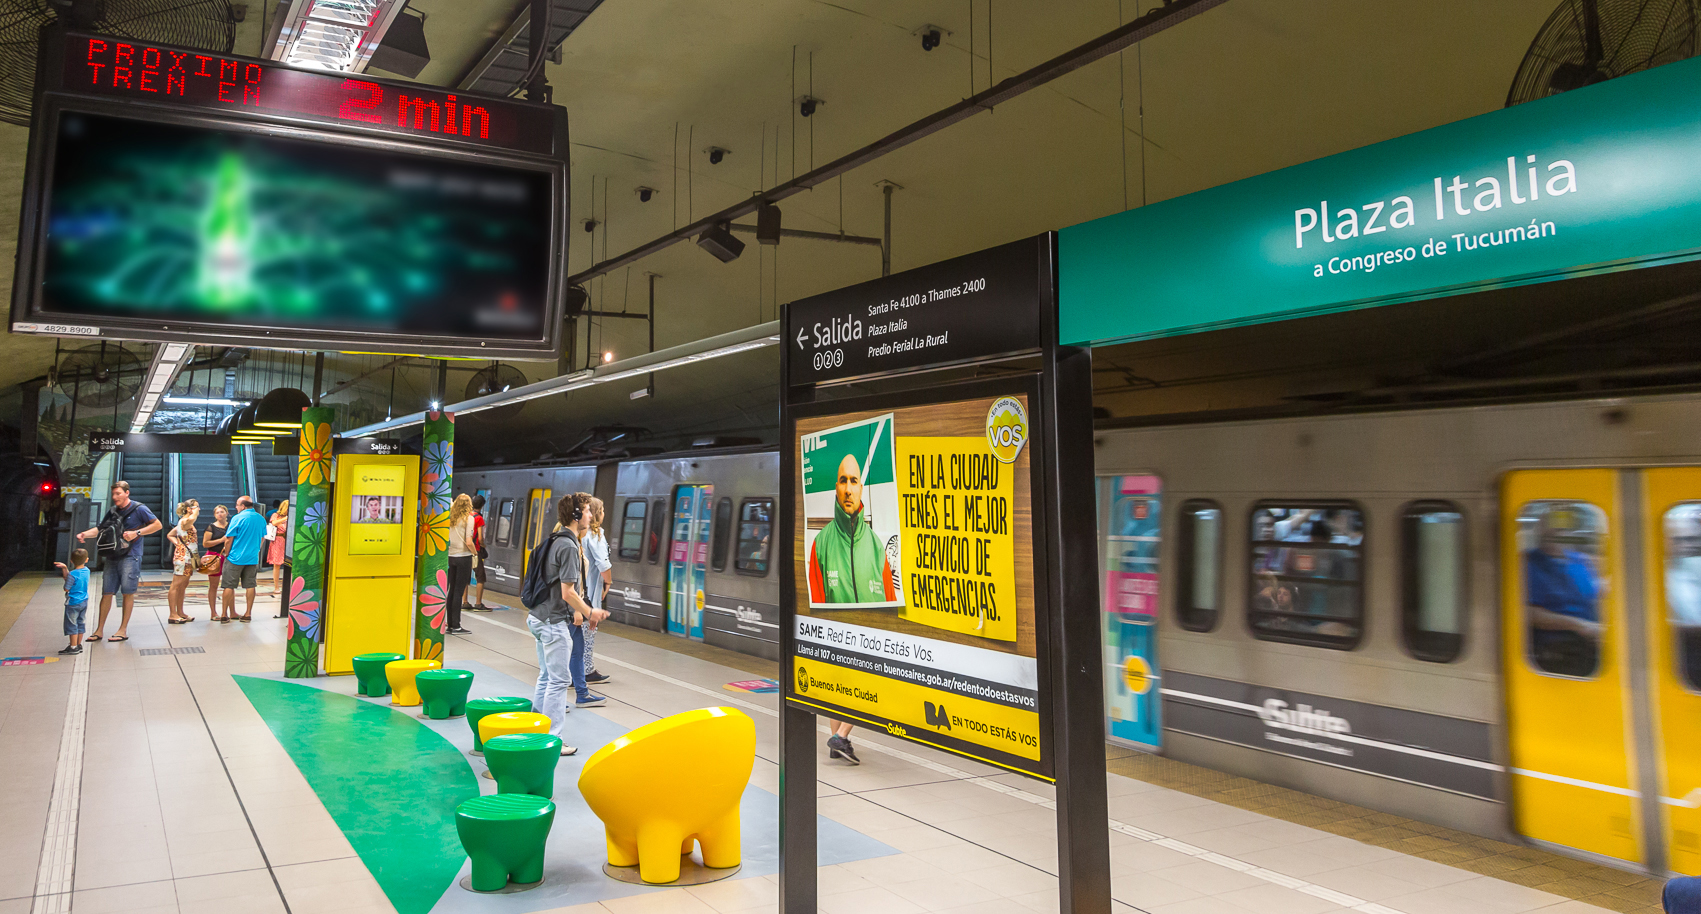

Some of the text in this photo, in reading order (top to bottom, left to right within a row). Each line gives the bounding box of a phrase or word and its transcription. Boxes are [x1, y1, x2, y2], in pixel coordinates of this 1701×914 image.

[88, 39, 261, 84] PROXIMO
[87, 62, 260, 106] TREN EN
[339, 79, 489, 139] 2 min
[1295, 154, 1577, 248] Plaza Italia
[1313, 219, 1556, 277] a Congreso de Tucumán
[868, 278, 985, 317] Santa Fe 4100 a Thames 2400
[44, 326, 92, 334] 4829.8900
[814, 314, 862, 348] Salida
[868, 319, 907, 337] Plaza Italia
[868, 331, 948, 358] Predio Ferial La Rural
[989, 424, 1023, 447] VOS
[910, 454, 998, 490] EN LA CIUDAD
[903, 490, 1008, 535] TENÉS EL MEJOR
[916, 534, 992, 576] SERVICIO DE
[911, 574, 1001, 620] EMERGENCIAS.
[800, 623, 934, 663] SAME. Red En Todo Estás Vos.
[798, 643, 813, 656] Llamá
[815, 647, 819, 657] al
[820, 648, 830, 660] 107
[837, 655, 873, 670] encontranos
[875, 663, 882, 672] en
[884, 663, 1034, 707] buenosaires.gob.ar/redentodoestasvos
[810, 677, 878, 703] Buenos Aires Ciudad
[887, 722, 906, 737] Subte
[952, 716, 1037, 747] EN TODO ESTÁS VOS
